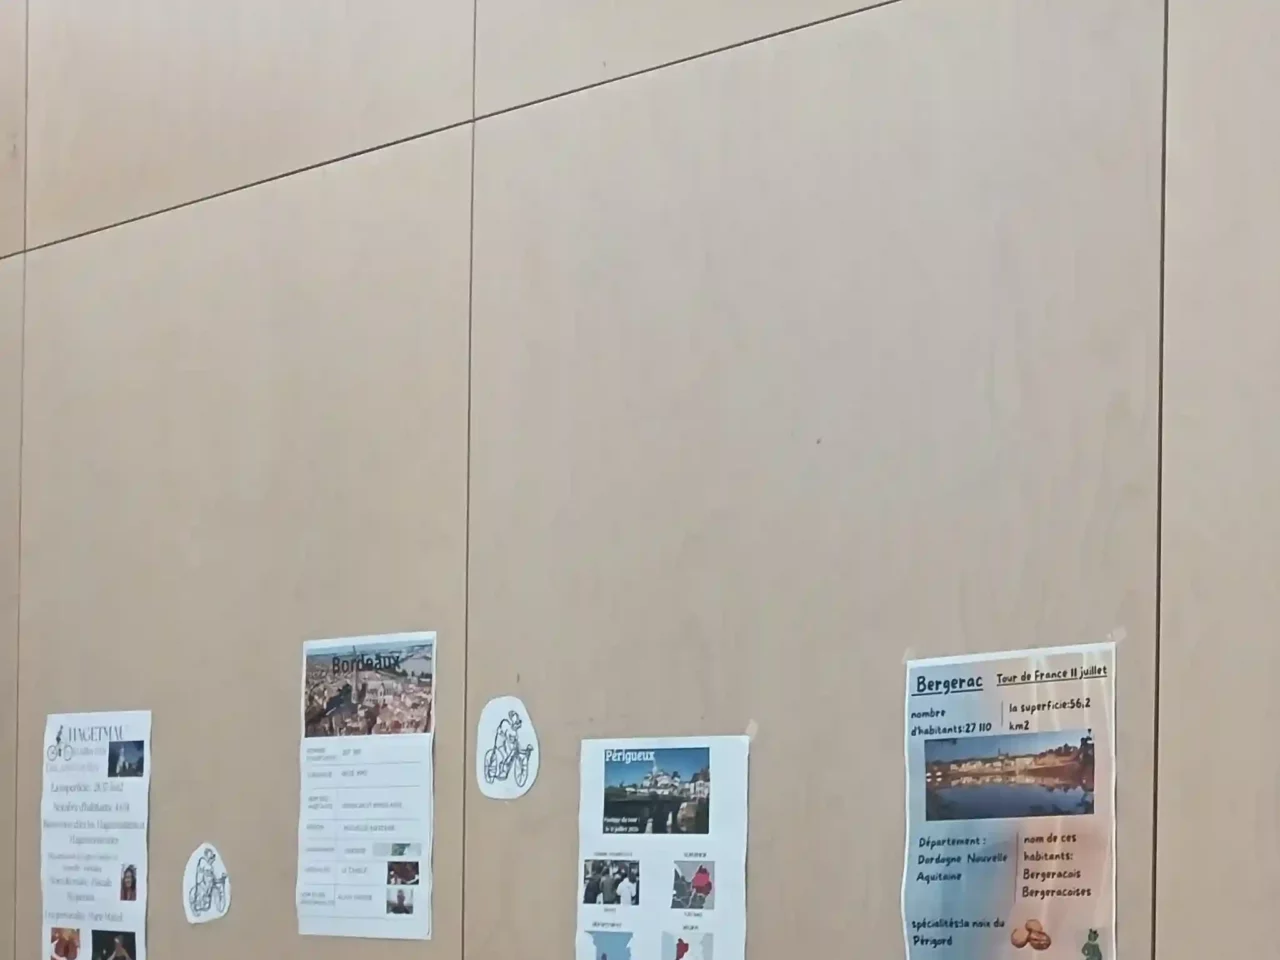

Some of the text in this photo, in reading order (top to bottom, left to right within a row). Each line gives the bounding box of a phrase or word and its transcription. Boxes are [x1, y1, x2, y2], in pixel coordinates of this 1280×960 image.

[332, 653, 400, 674] Bordeaux
[996, 673, 1018, 684] Tour
[1020, 671, 1031, 681] de
[1034, 669, 1068, 681] France
[1079, 665, 1107, 680] juillet
[916, 675, 984, 695] Bergerac
[910, 708, 946, 719] nombre
[1009, 703, 1018, 713] la
[978, 722, 992, 732] 110
[1009, 720, 1030, 731] km2
[605, 749, 655, 764] Périgueux
[918, 835, 980, 850] Département
[1023, 833, 1077, 844] nom de ces
[917, 852, 1008, 867] Dordogne Nouvelle
[1023, 851, 1073, 861] habitants:
[916, 872, 962, 884] Aquitaine
[1023, 868, 1081, 882] Bergeracois
[1022, 886, 1092, 900] Bergeracoises
[972, 919, 990, 928] noix
[993, 918, 1005, 928] du
[913, 935, 953, 948] Périgord
